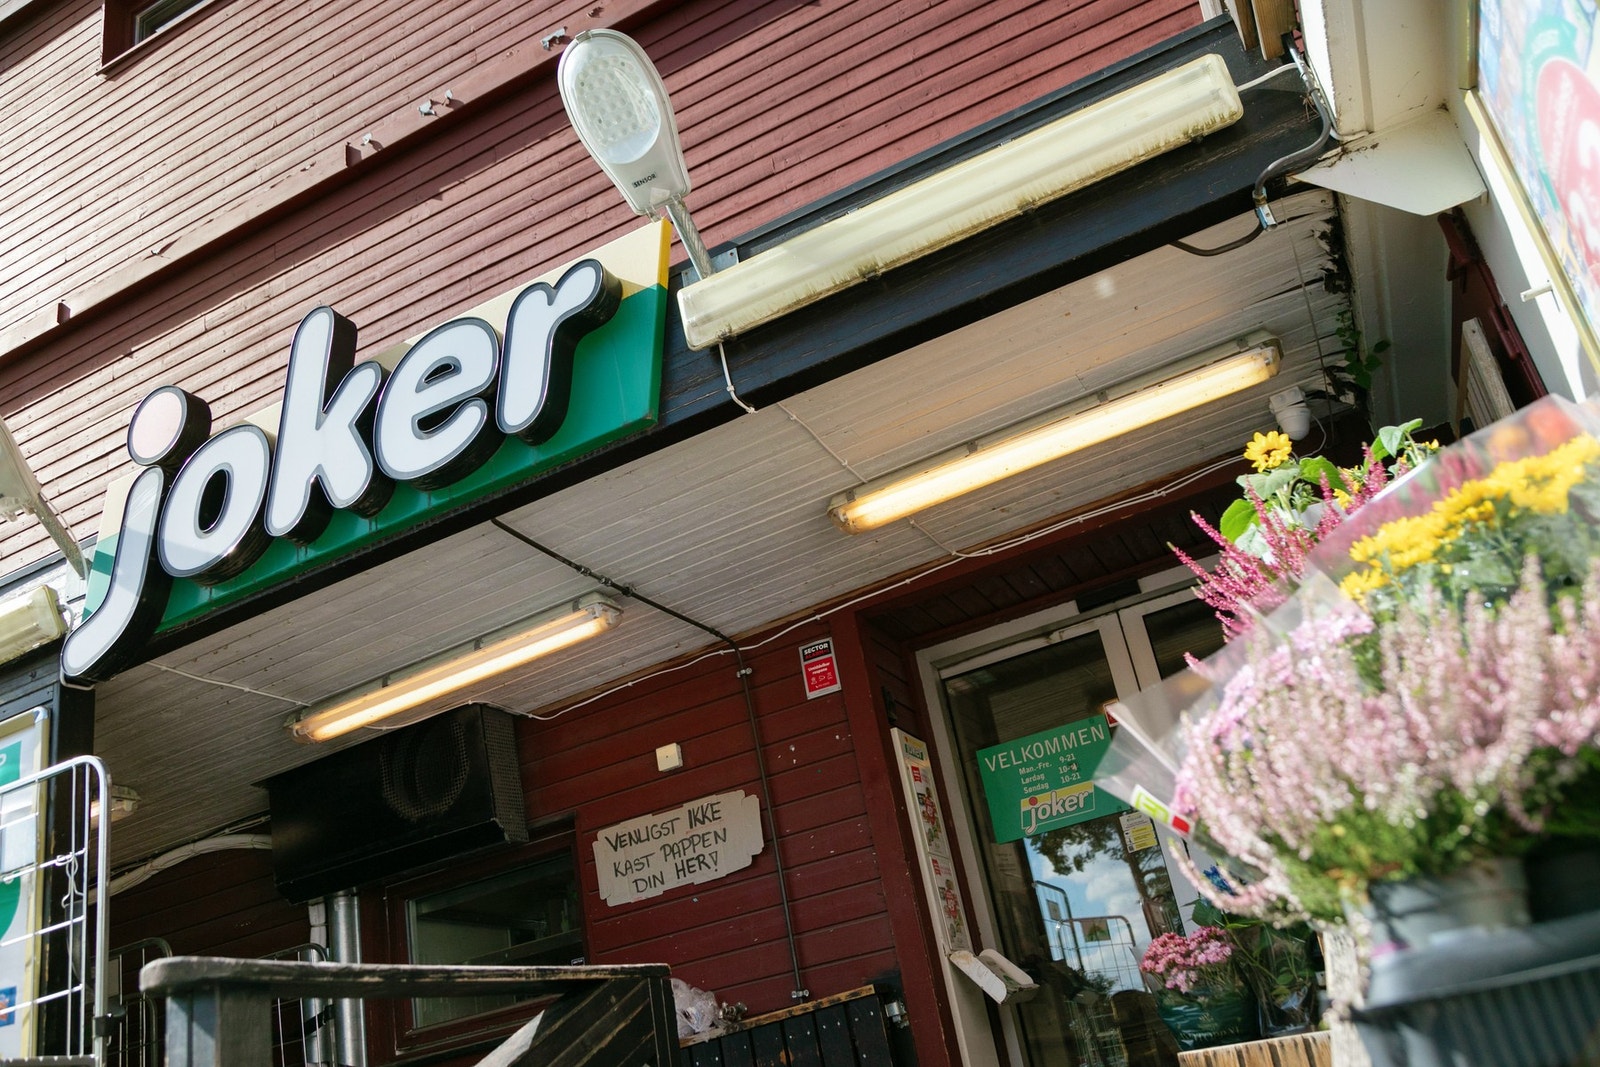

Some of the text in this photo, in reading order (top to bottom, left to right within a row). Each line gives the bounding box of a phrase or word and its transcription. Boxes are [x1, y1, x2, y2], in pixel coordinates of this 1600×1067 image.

[633, 173, 657, 188] SENSOR
[60, 258, 606, 679] joker
[803, 642, 829, 655] SECTOR
[984, 724, 1105, 772] VELKOMMEN
[1059, 753, 1076, 763] 9-21
[1021, 773, 1046, 784] Lørdag
[1023, 772, 1081, 794] Søndag 10-21
[605, 801, 722, 852] VENLIGST IKKE
[1025, 790, 1089, 835] joker
[613, 827, 727, 877] KAST PAPPEN
[632, 851, 719, 893] DIN HER!
